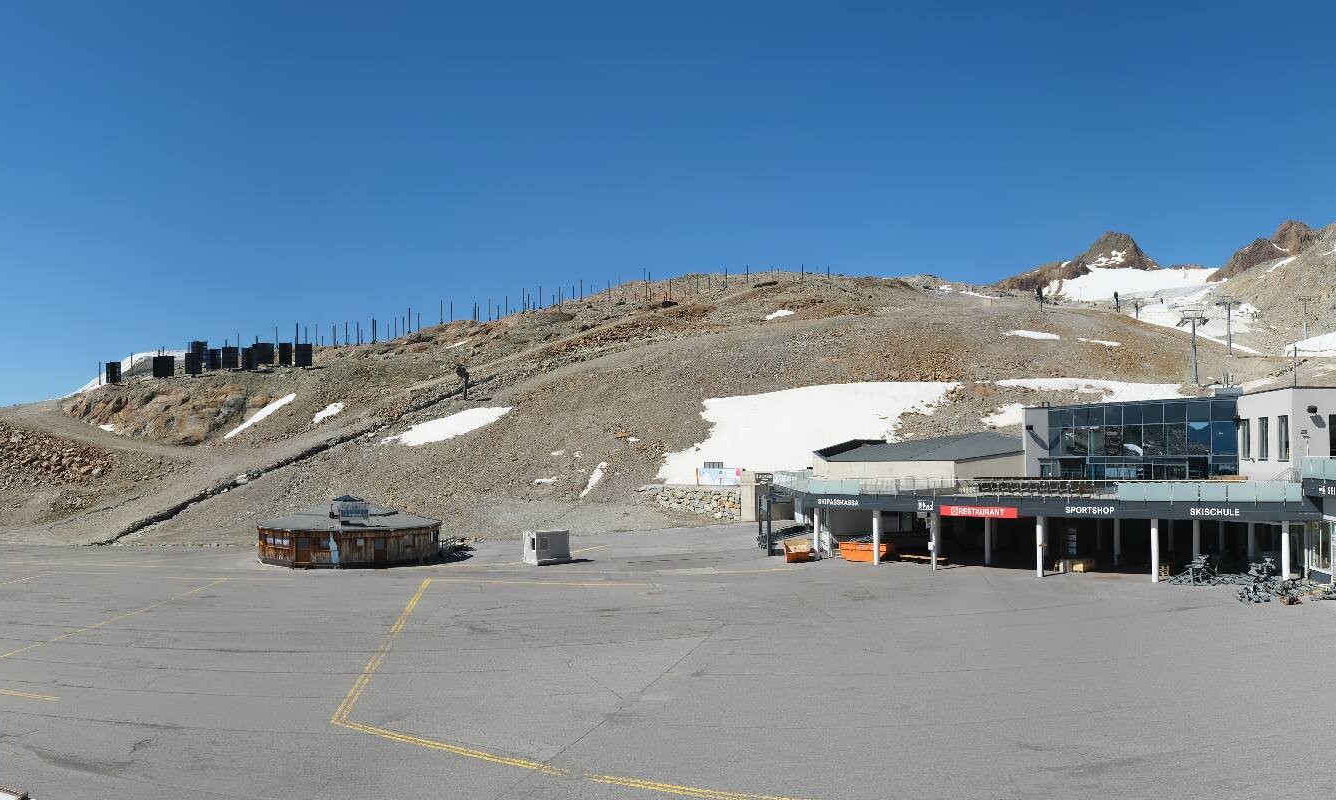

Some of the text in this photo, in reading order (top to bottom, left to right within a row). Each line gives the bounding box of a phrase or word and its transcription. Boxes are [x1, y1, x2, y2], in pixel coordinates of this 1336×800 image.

[958, 507, 1005, 516] RESTAURANT
[1065, 506, 1115, 515] SPORTSHOP
[1190, 507, 1240, 516] SKISCHULE
